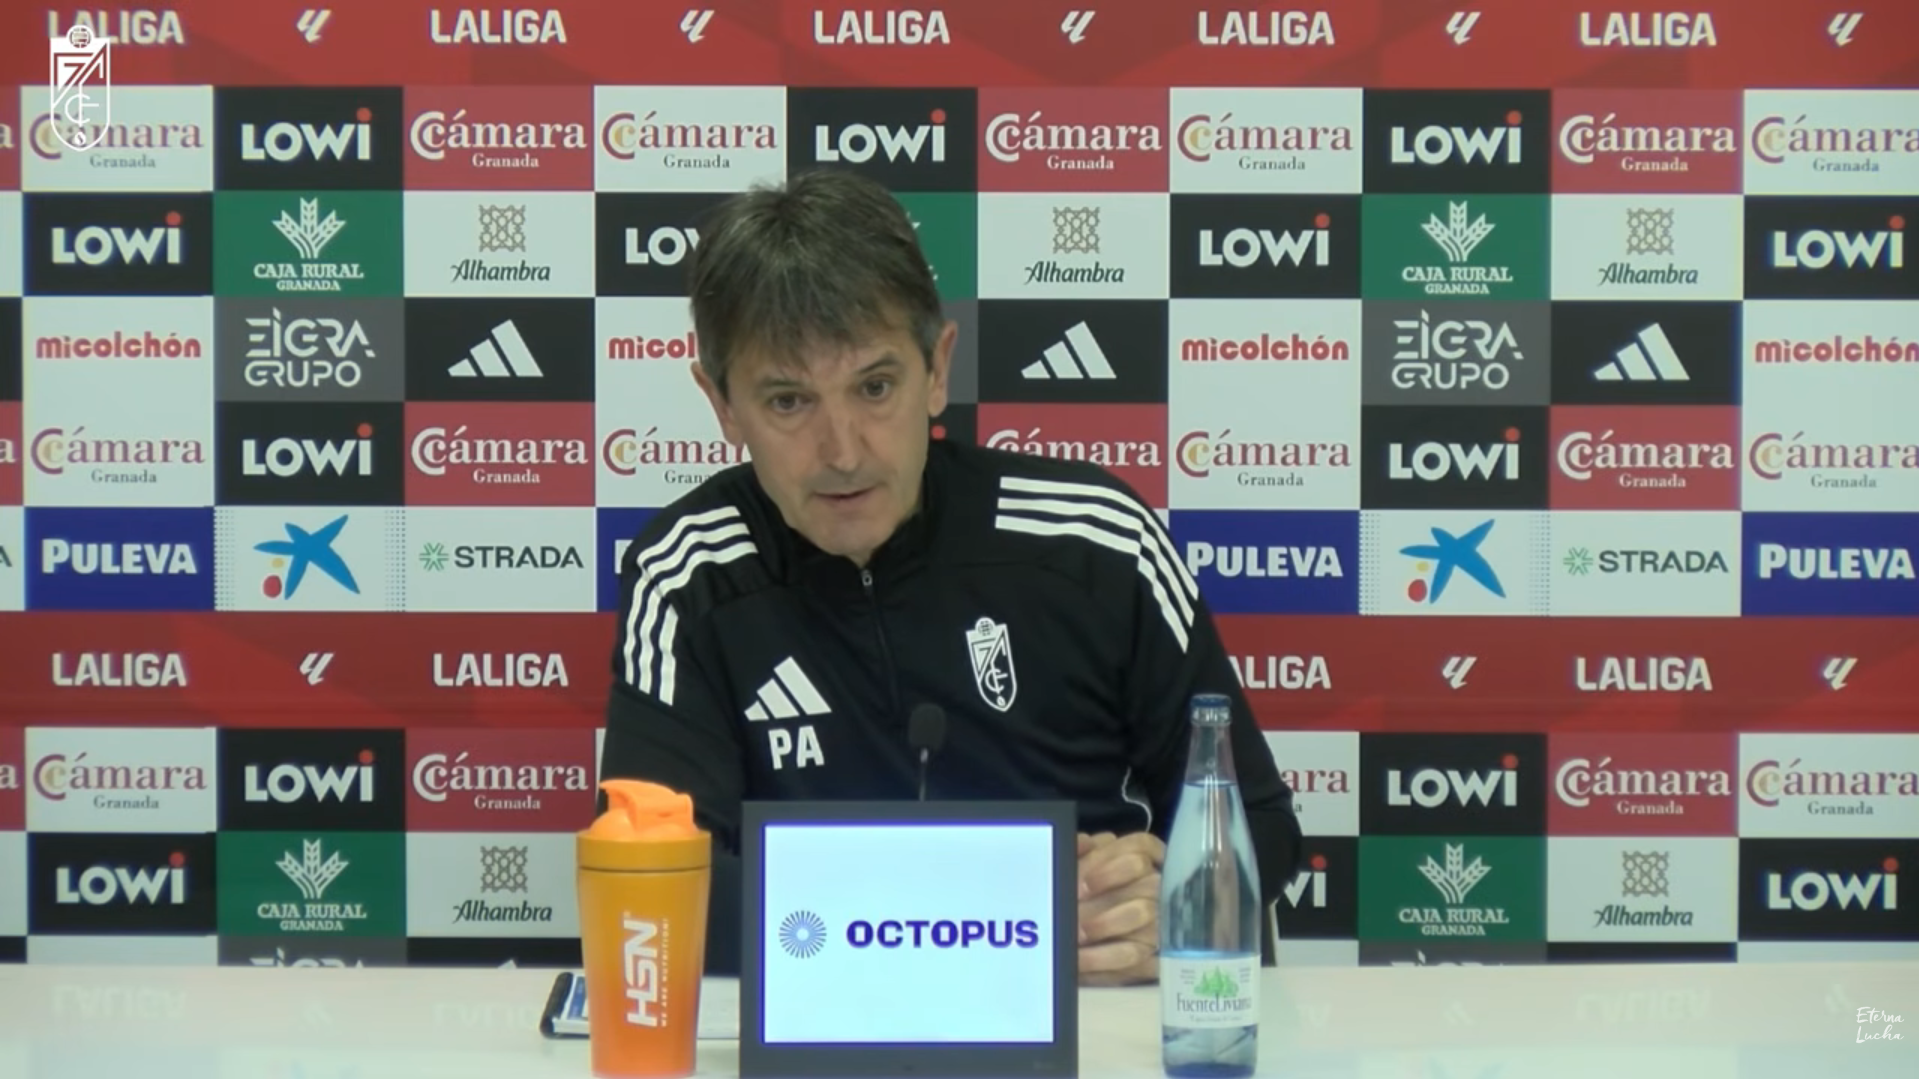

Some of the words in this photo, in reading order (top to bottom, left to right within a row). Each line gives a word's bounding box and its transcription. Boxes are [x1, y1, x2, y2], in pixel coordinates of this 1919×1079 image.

[431, 9, 566, 43] LALIGA
[815, 10, 950, 44] LALIGA
[1199, 11, 1334, 45] LALIGA
[1581, 12, 1716, 46] LALIGA
[90, 154, 156, 168] Granada
[472, 153, 538, 167] Granada
[664, 155, 729, 168] Granada
[1047, 156, 1113, 169] Granada
[1239, 156, 1305, 169] Granada
[1621, 157, 1688, 171] Granada
[1813, 158, 1879, 171] Granada
[625, 226, 700, 266] LO
[254, 264, 297, 279] CAJA
[300, 264, 364, 279] RURAL
[451, 259, 550, 282] Alhambra
[1025, 261, 1124, 283] Alhambra
[1402, 267, 1445, 282] CAJA
[1448, 267, 1512, 282] RURAL
[1598, 263, 1698, 285] Alhambra
[276, 279, 340, 290] GRANADA
[1425, 283, 1489, 294] GRANADA
[609, 332, 695, 359] micol
[245, 360, 361, 387] GRUPO
[1392, 363, 1509, 389] GRUPO
[91, 469, 157, 483] Granada
[474, 469, 540, 483] Granada
[1237, 473, 1303, 486] Granada
[1619, 474, 1686, 487] Granada
[1811, 474, 1876, 487] Granada
[43, 539, 197, 573] PULEVA
[455, 546, 583, 568] STRADA
[1187, 541, 1343, 577] PULEVA
[1599, 550, 1728, 573] STRADA
[1759, 544, 1915, 579] PULEVA
[53, 653, 187, 686] LALIGA
[434, 654, 568, 686] LALIGA
[1228, 656, 1331, 689] LIGA
[1577, 657, 1712, 690] LALIGA
[768, 726, 824, 769] PA
[93, 795, 159, 808] Granada
[474, 795, 540, 809] Granada
[1617, 800, 1683, 814] Granada
[1807, 801, 1873, 815] Granada
[258, 903, 301, 918] CAJA
[304, 903, 368, 918] RURAL
[453, 900, 552, 922] Alhambra
[1399, 908, 1442, 923] CAJA
[1445, 908, 1509, 923] RURAL
[1594, 905, 1693, 926] Alhambra
[280, 919, 343, 930] GRANADA
[847, 920, 1038, 948] OCTOPUS
[1422, 924, 1485, 935] GRANADA
[623, 919, 658, 1027] HSN
